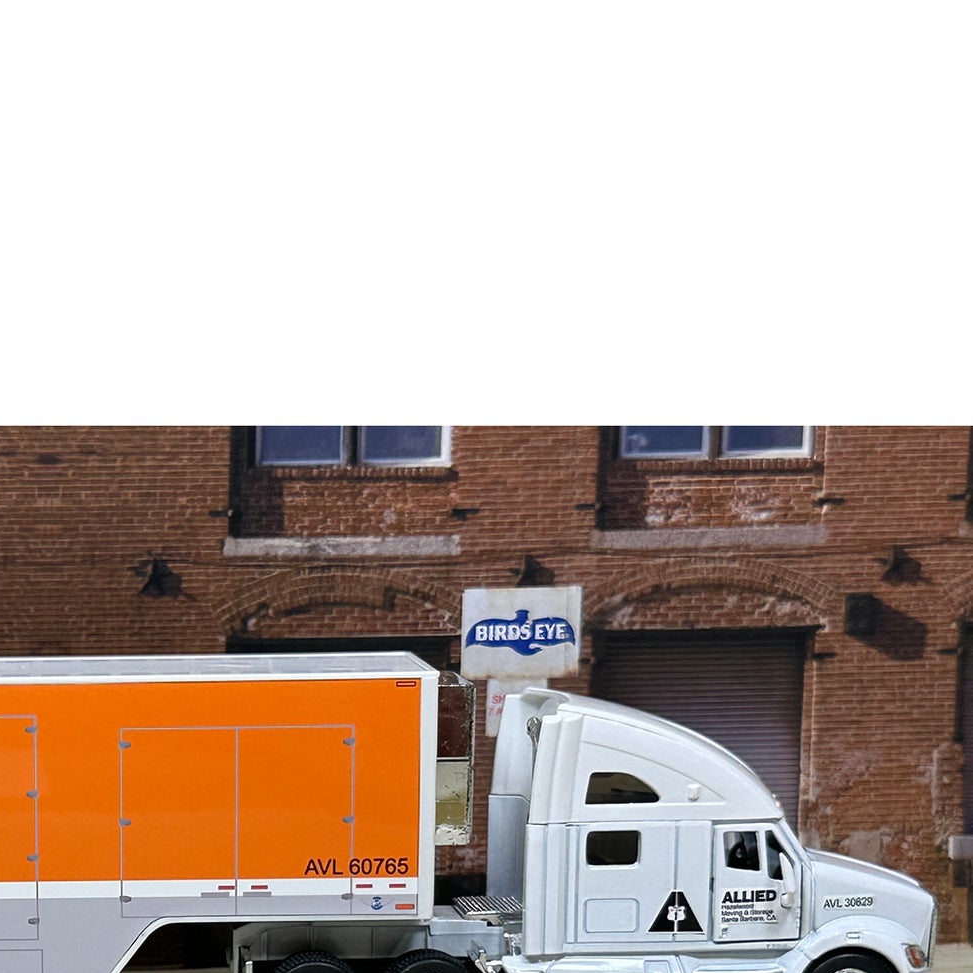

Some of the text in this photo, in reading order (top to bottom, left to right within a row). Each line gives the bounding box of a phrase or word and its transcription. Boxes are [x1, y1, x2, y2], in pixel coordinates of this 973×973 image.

[534, 623, 566, 640] EYE
[304, 857, 409, 876] AVL 60765
[721, 889, 777, 904] ALLIED
[823, 898, 843, 909] AVL
